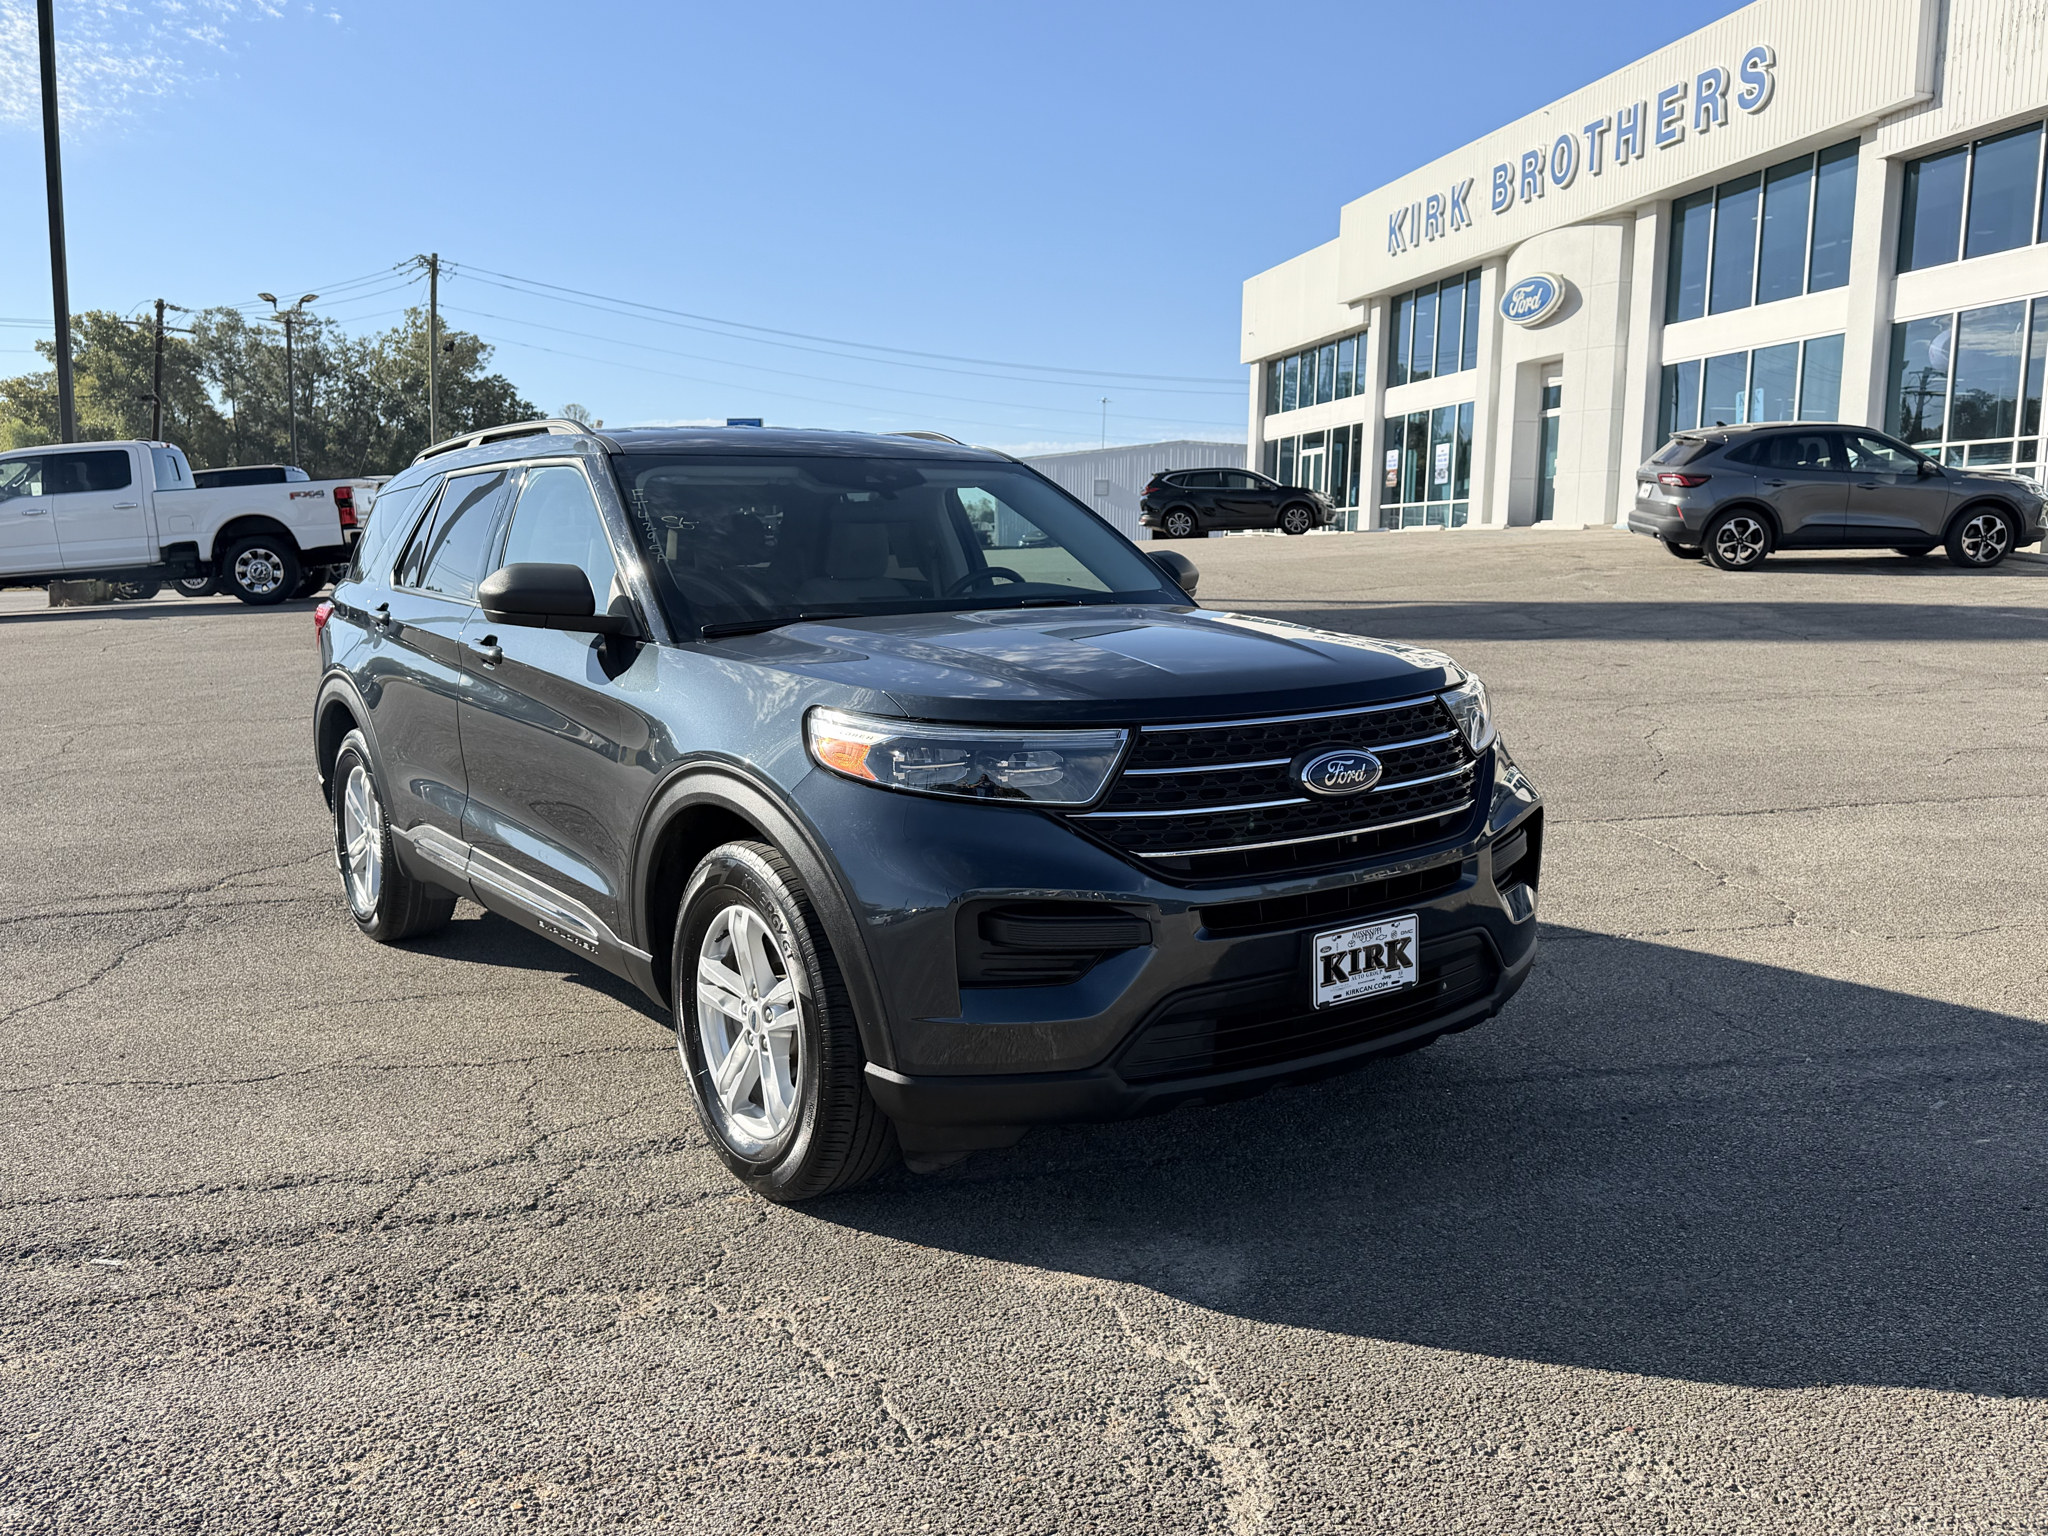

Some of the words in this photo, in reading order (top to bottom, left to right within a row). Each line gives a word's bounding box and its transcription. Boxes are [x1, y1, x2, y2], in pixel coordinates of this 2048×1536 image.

[1387, 178, 1474, 256] KIRK
[1491, 44, 1776, 216] BROTHERS
[1509, 284, 1543, 316] Ford
[289, 489, 325, 500] FX4
[1324, 759, 1366, 786] Ford
[782, 940, 795, 960] GT
[1320, 936, 1413, 988] KIRK
[1351, 971, 1365, 981] AUTO
[1365, 969, 1383, 978] GROUP
[1345, 981, 1389, 996] KIRKCAN.COM
